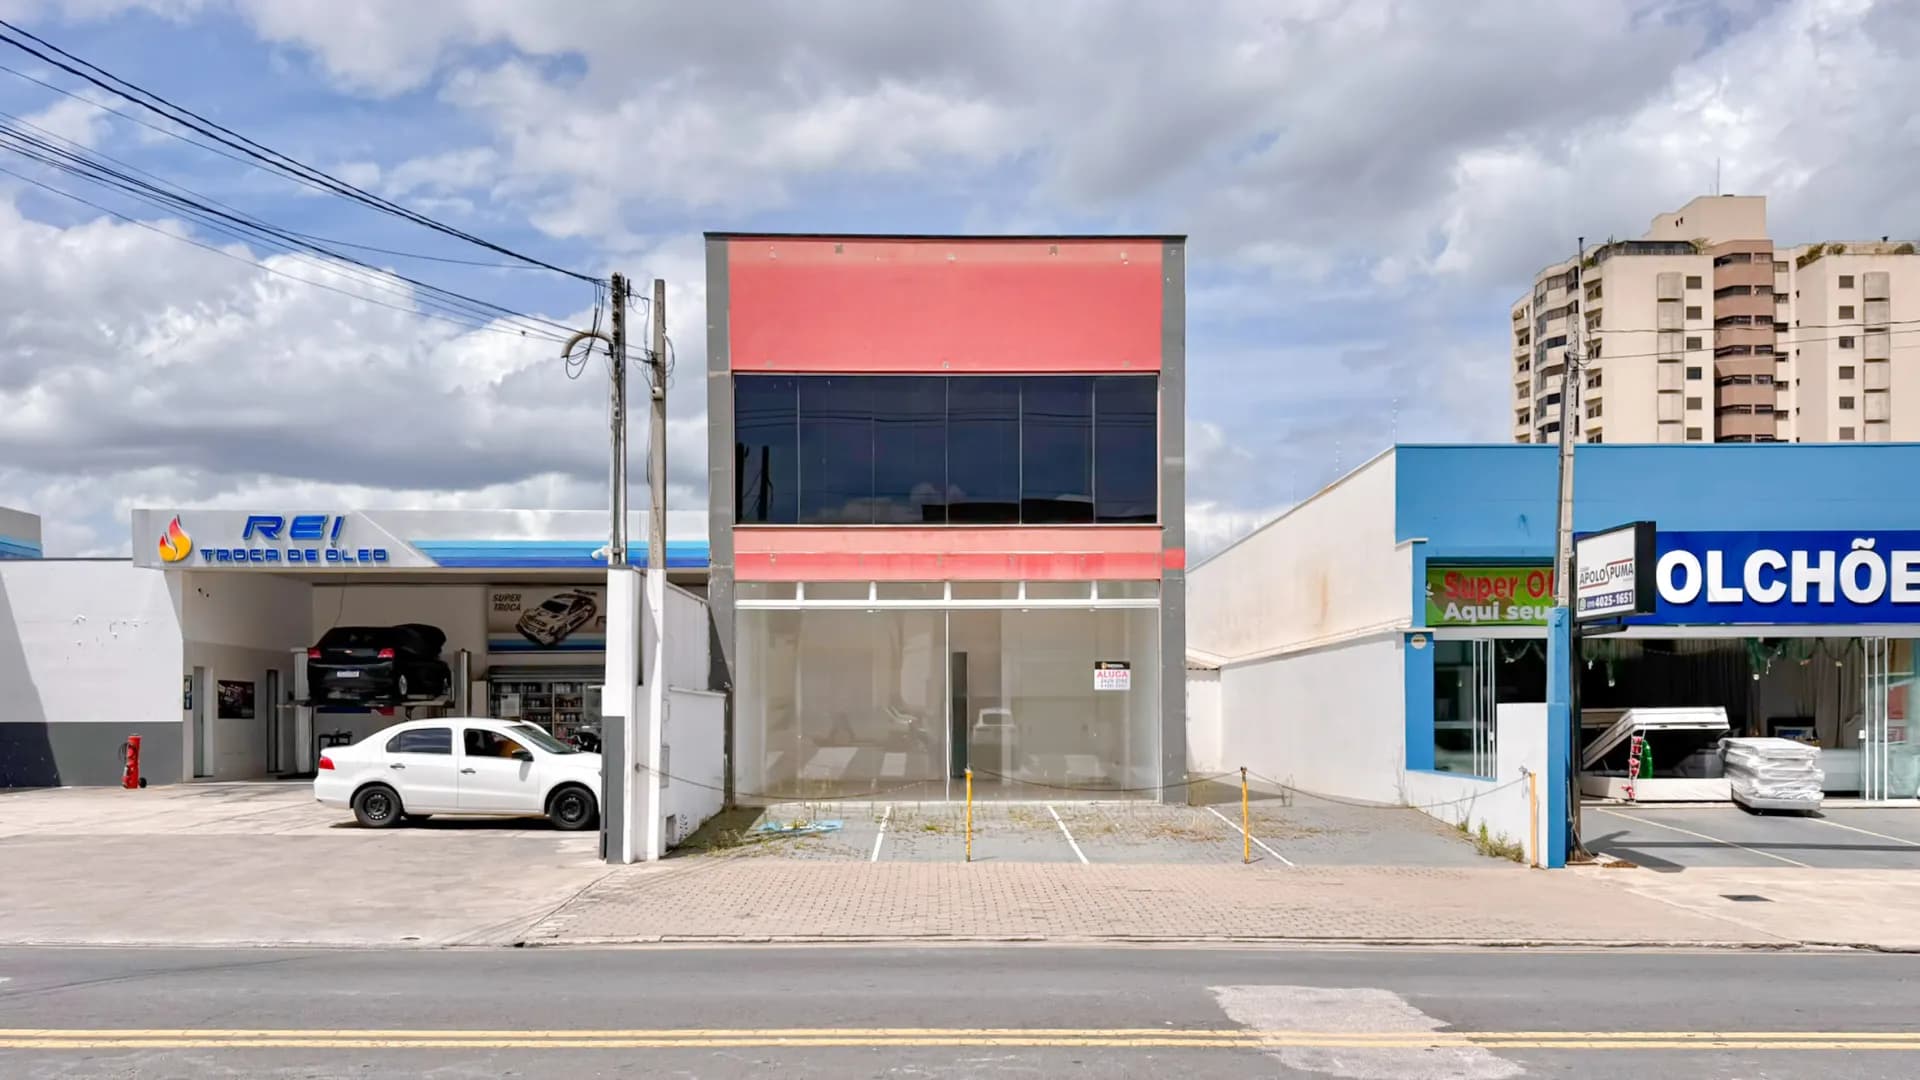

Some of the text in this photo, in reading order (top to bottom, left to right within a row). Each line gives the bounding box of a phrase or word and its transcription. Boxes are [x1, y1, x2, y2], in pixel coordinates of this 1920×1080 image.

[242, 515, 345, 541] REI
[200, 548, 281, 563] TROCA
[287, 548, 319, 563] DE
[1444, 571, 1518, 604] Super
[493, 593, 521, 602] SUPER
[1595, 591, 1632, 608] 4025-1651
[494, 602, 521, 611] TROCA
[1444, 602, 1549, 624] Aqui seu
